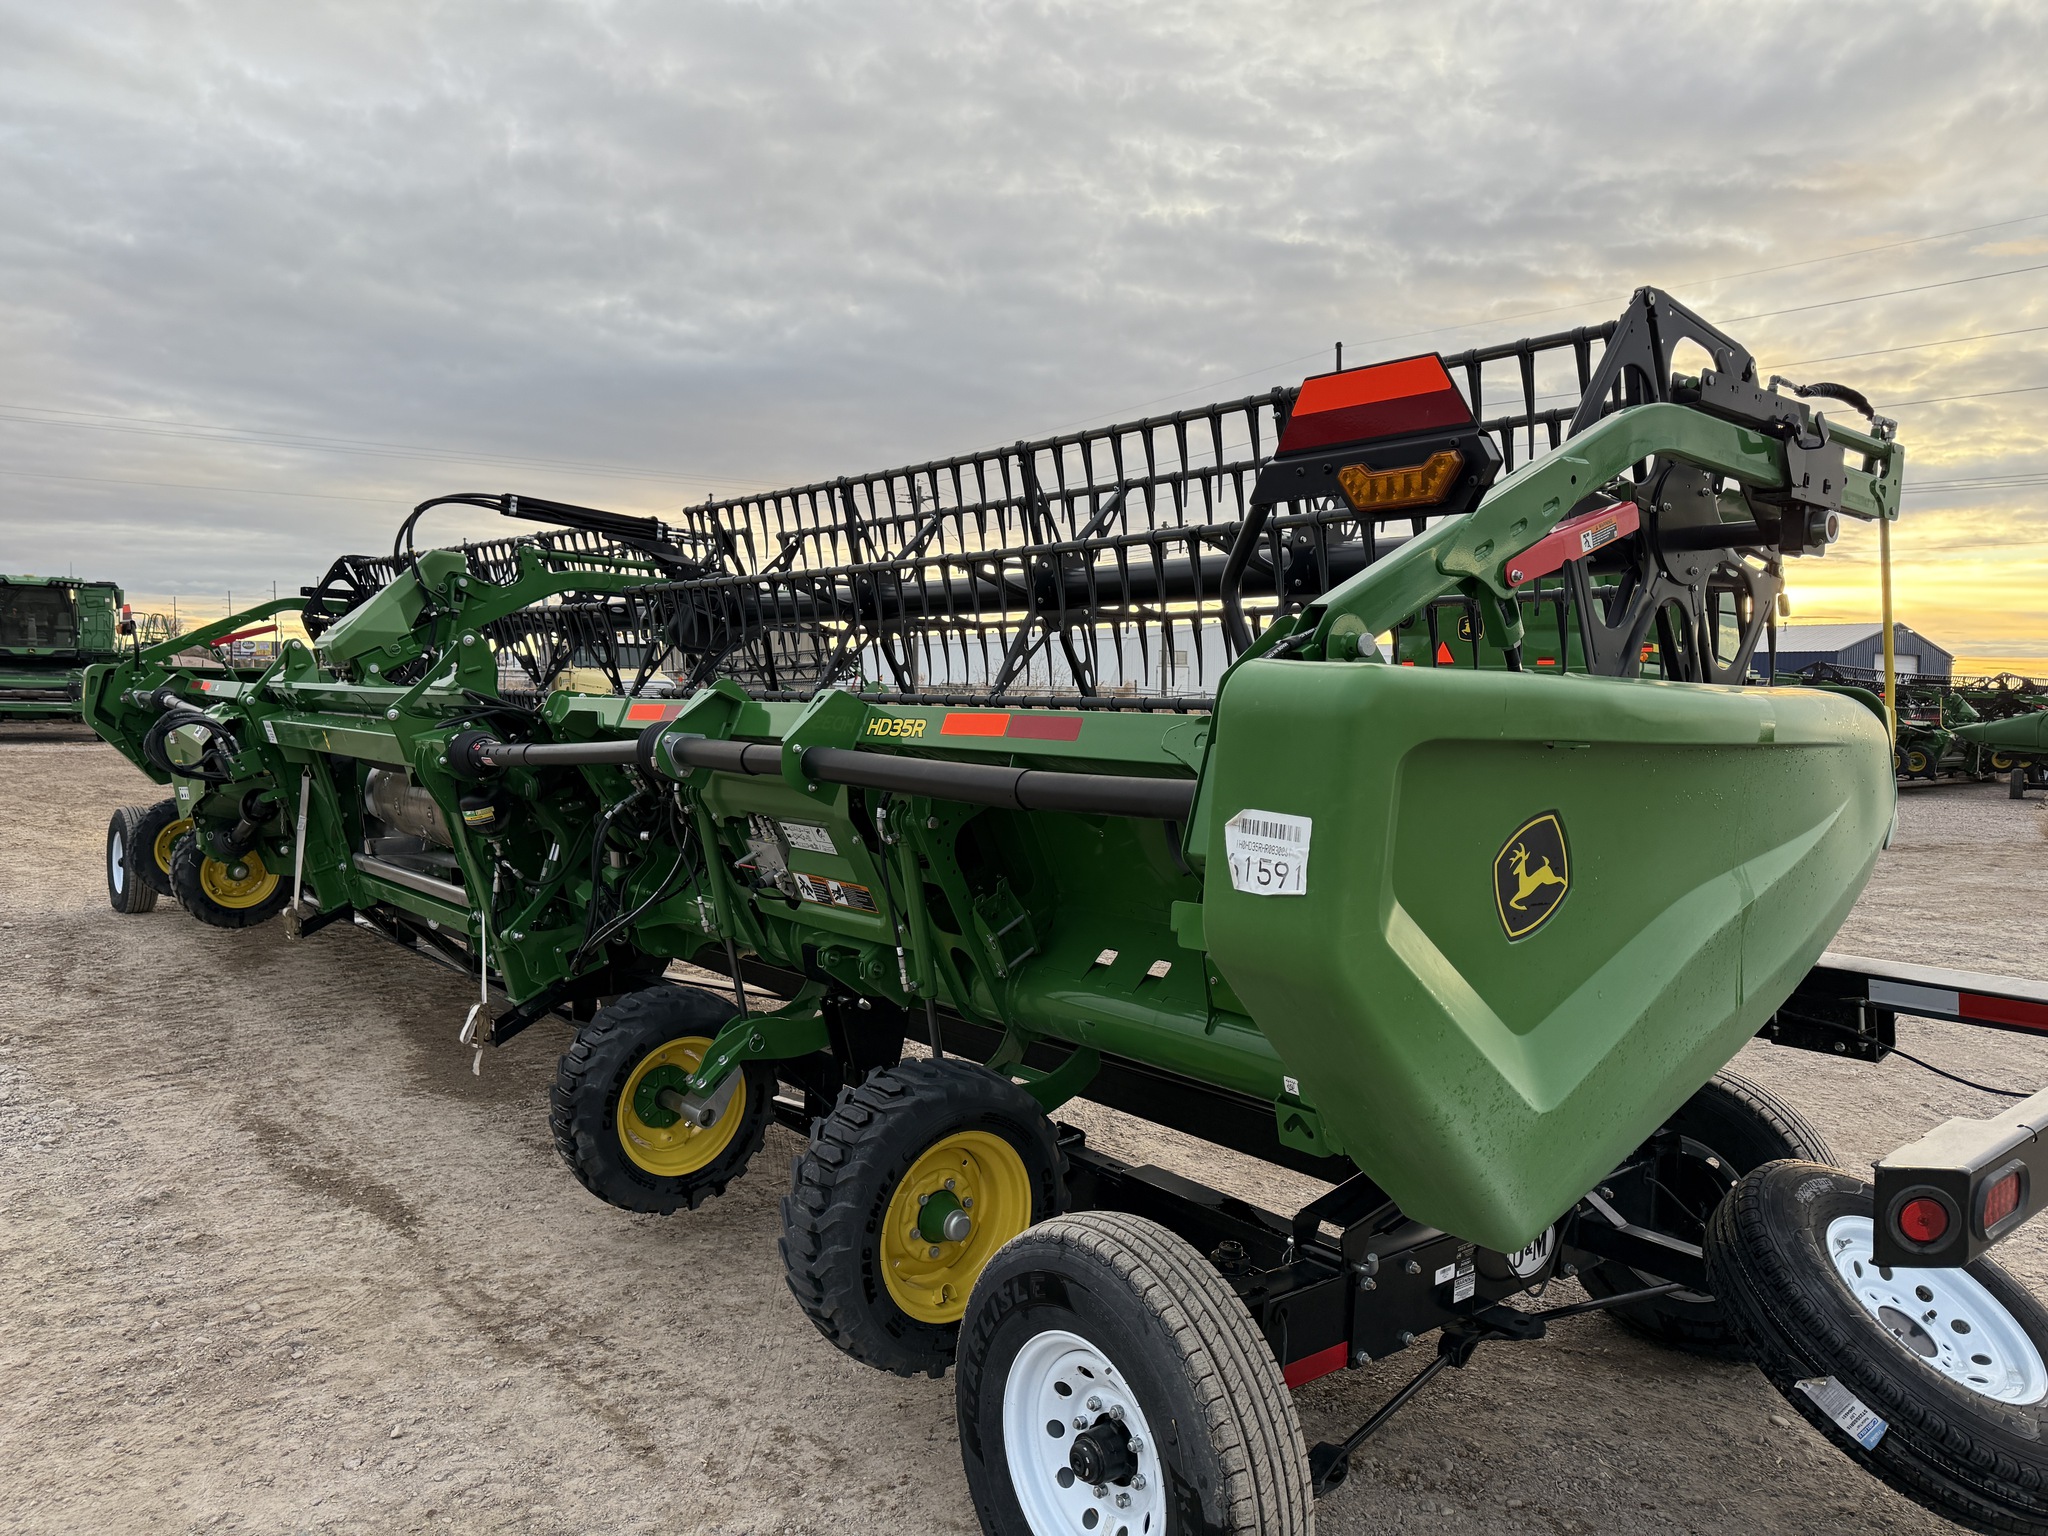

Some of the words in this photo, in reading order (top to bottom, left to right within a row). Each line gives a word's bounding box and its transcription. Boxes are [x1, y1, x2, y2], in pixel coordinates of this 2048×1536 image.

[866, 718, 927, 738] HD35R
[862, 1247, 877, 1304] TRAC
[964, 1274, 1047, 1420] CARLISLE
